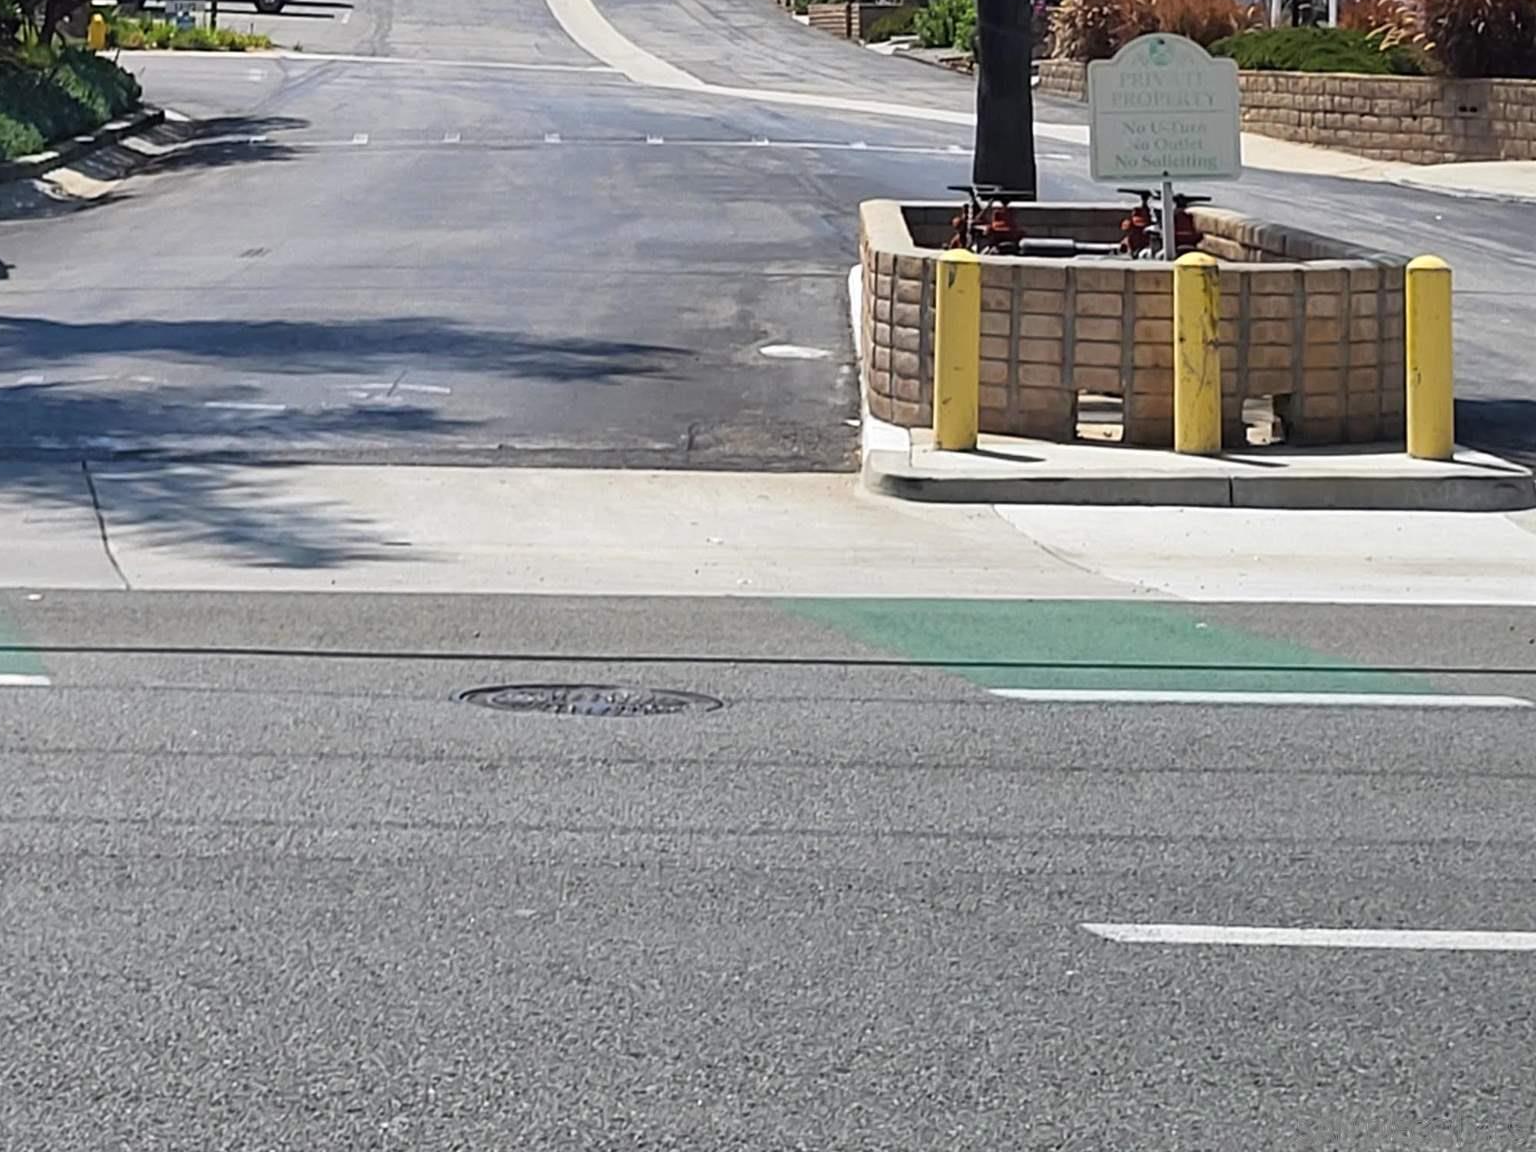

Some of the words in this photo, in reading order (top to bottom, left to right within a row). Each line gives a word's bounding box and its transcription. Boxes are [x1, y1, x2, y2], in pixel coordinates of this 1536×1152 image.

[1111, 90, 1215, 106] PROPERTY
[1123, 121, 1146, 135] No
[1150, 121, 1208, 136] U-Turn
[1153, 137, 1204, 151] Outlet
[1114, 153, 1138, 168] No
[1142, 153, 1217, 171] Soliciting
